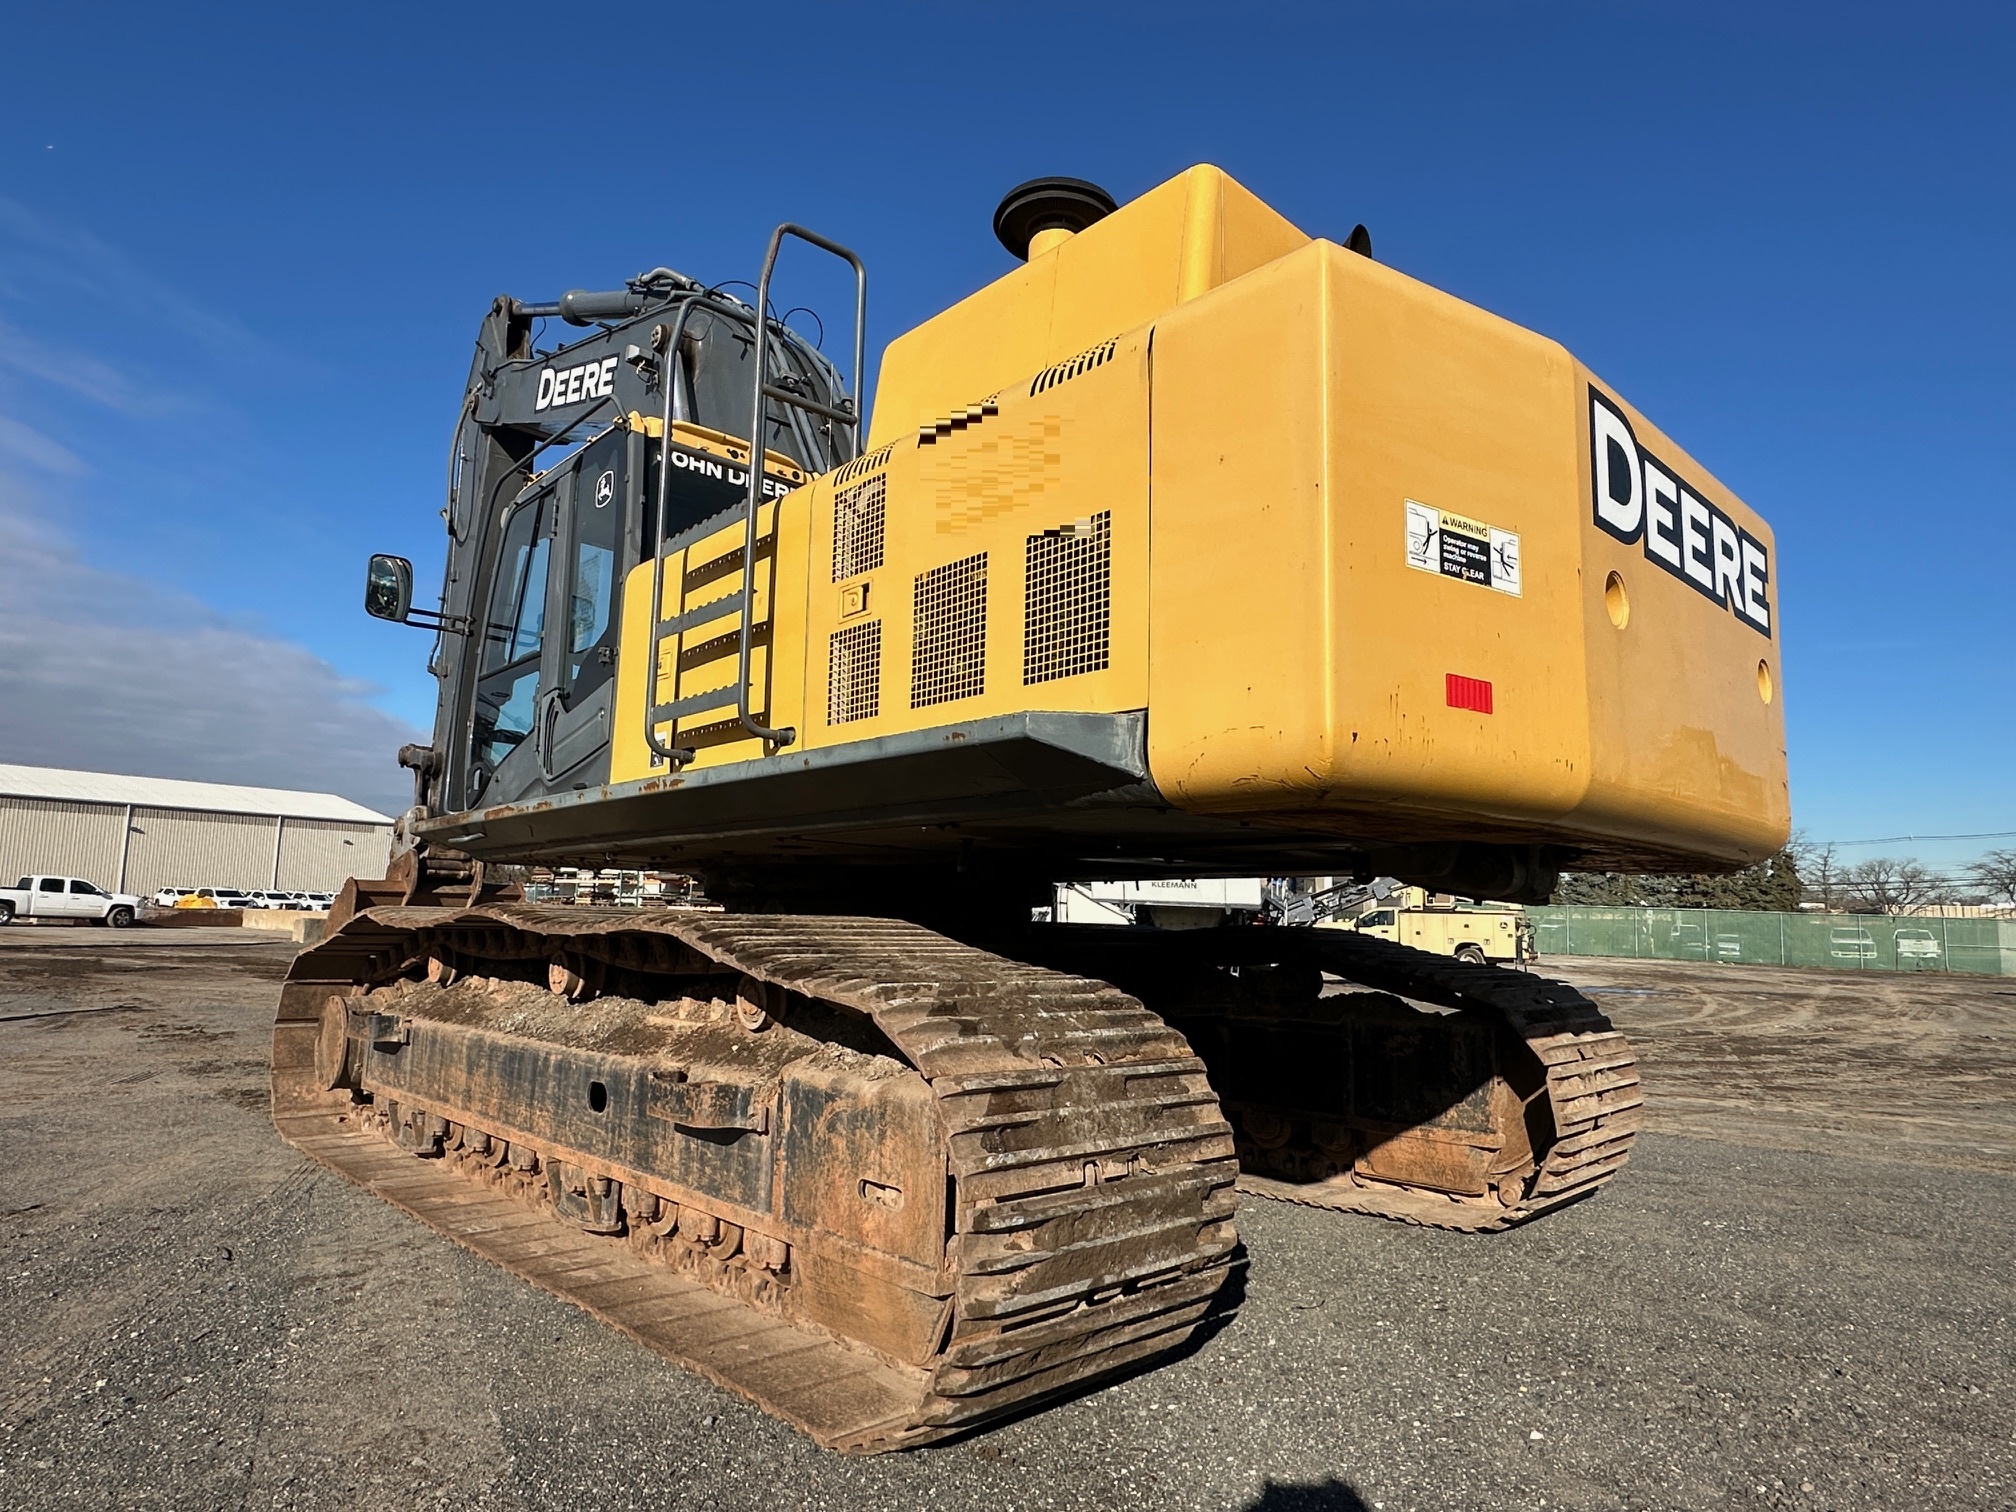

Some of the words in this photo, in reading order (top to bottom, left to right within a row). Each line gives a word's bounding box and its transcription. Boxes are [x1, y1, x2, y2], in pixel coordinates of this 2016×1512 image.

[535, 357, 618, 411] DEERE
[656, 451, 722, 480] OHN
[728, 468, 796, 498] DER
[1449, 517, 1488, 538] WARNING
[1594, 399, 1769, 628] DEERE
[1443, 561, 1460, 575] STAY
[1461, 567, 1485, 581] CLEAR
[1151, 881, 1198, 890] KLEEMANN
